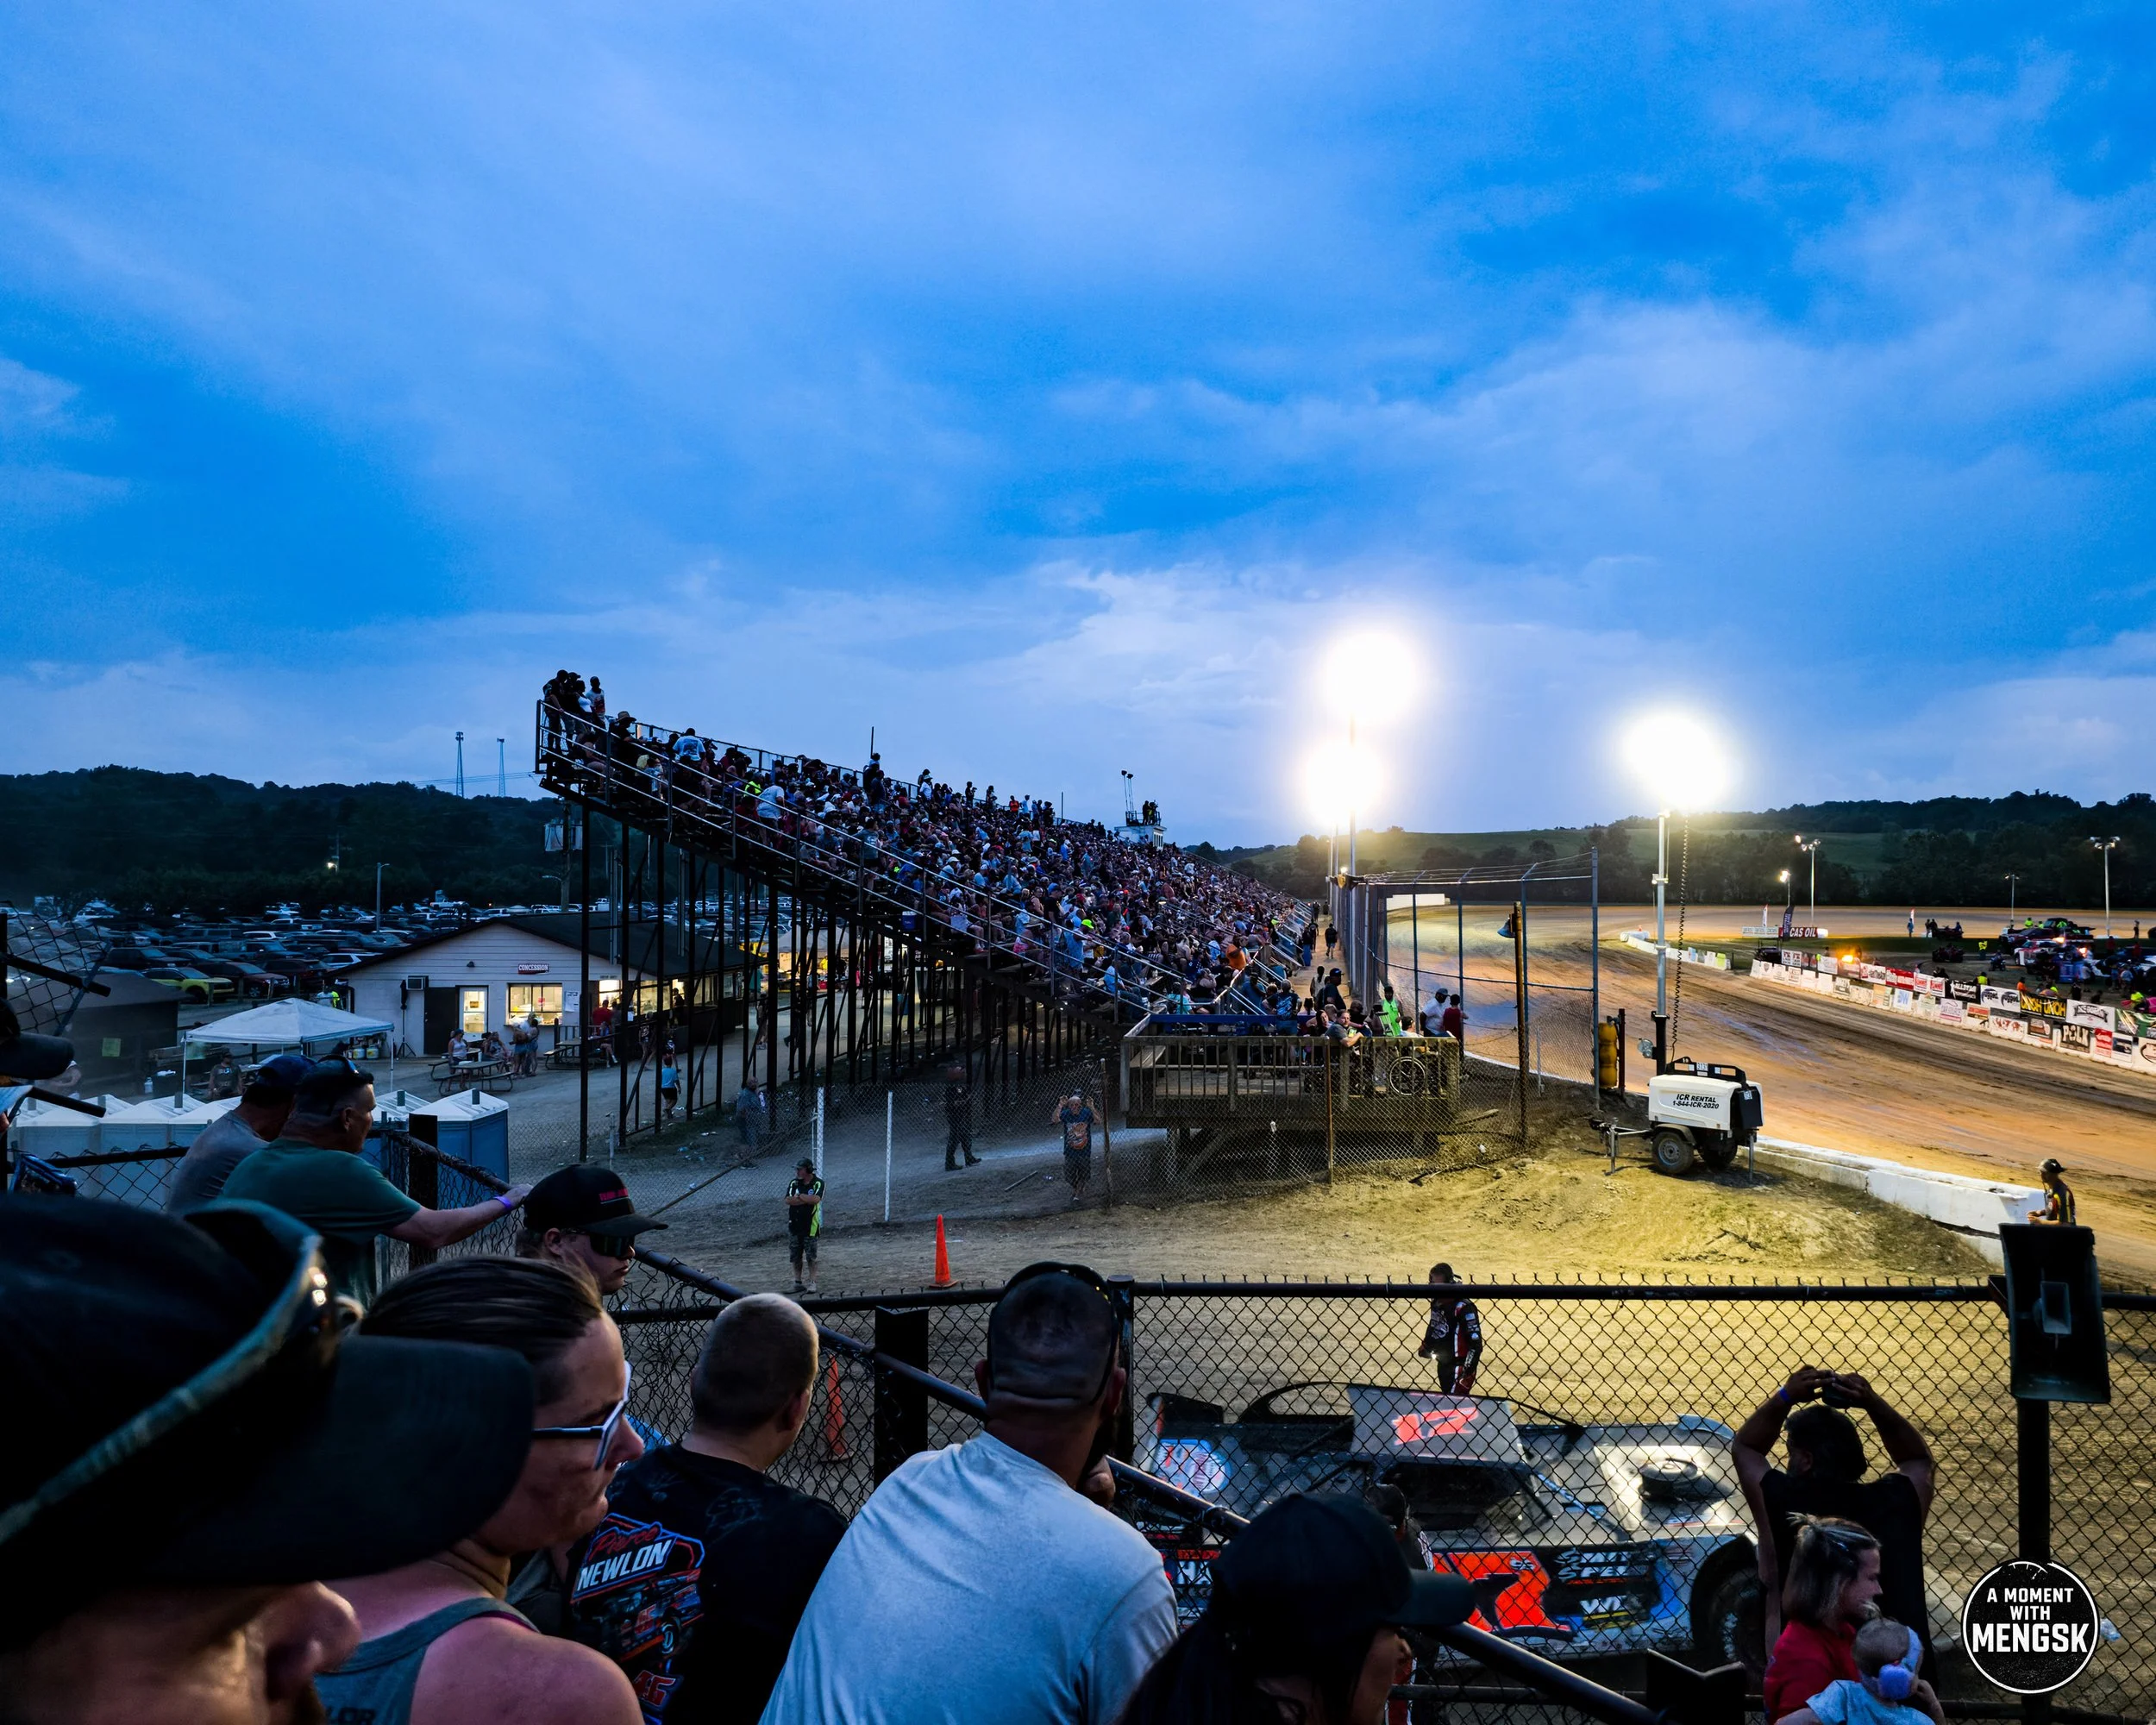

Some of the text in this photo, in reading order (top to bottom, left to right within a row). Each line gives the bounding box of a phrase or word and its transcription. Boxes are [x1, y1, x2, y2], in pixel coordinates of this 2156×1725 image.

[1781, 927, 1803, 938] CAS
[1804, 927, 1816, 938] OIL
[1673, 1101, 1720, 1109] 1-844-ICR-2020
[576, 1540, 673, 1592] NEWLON
